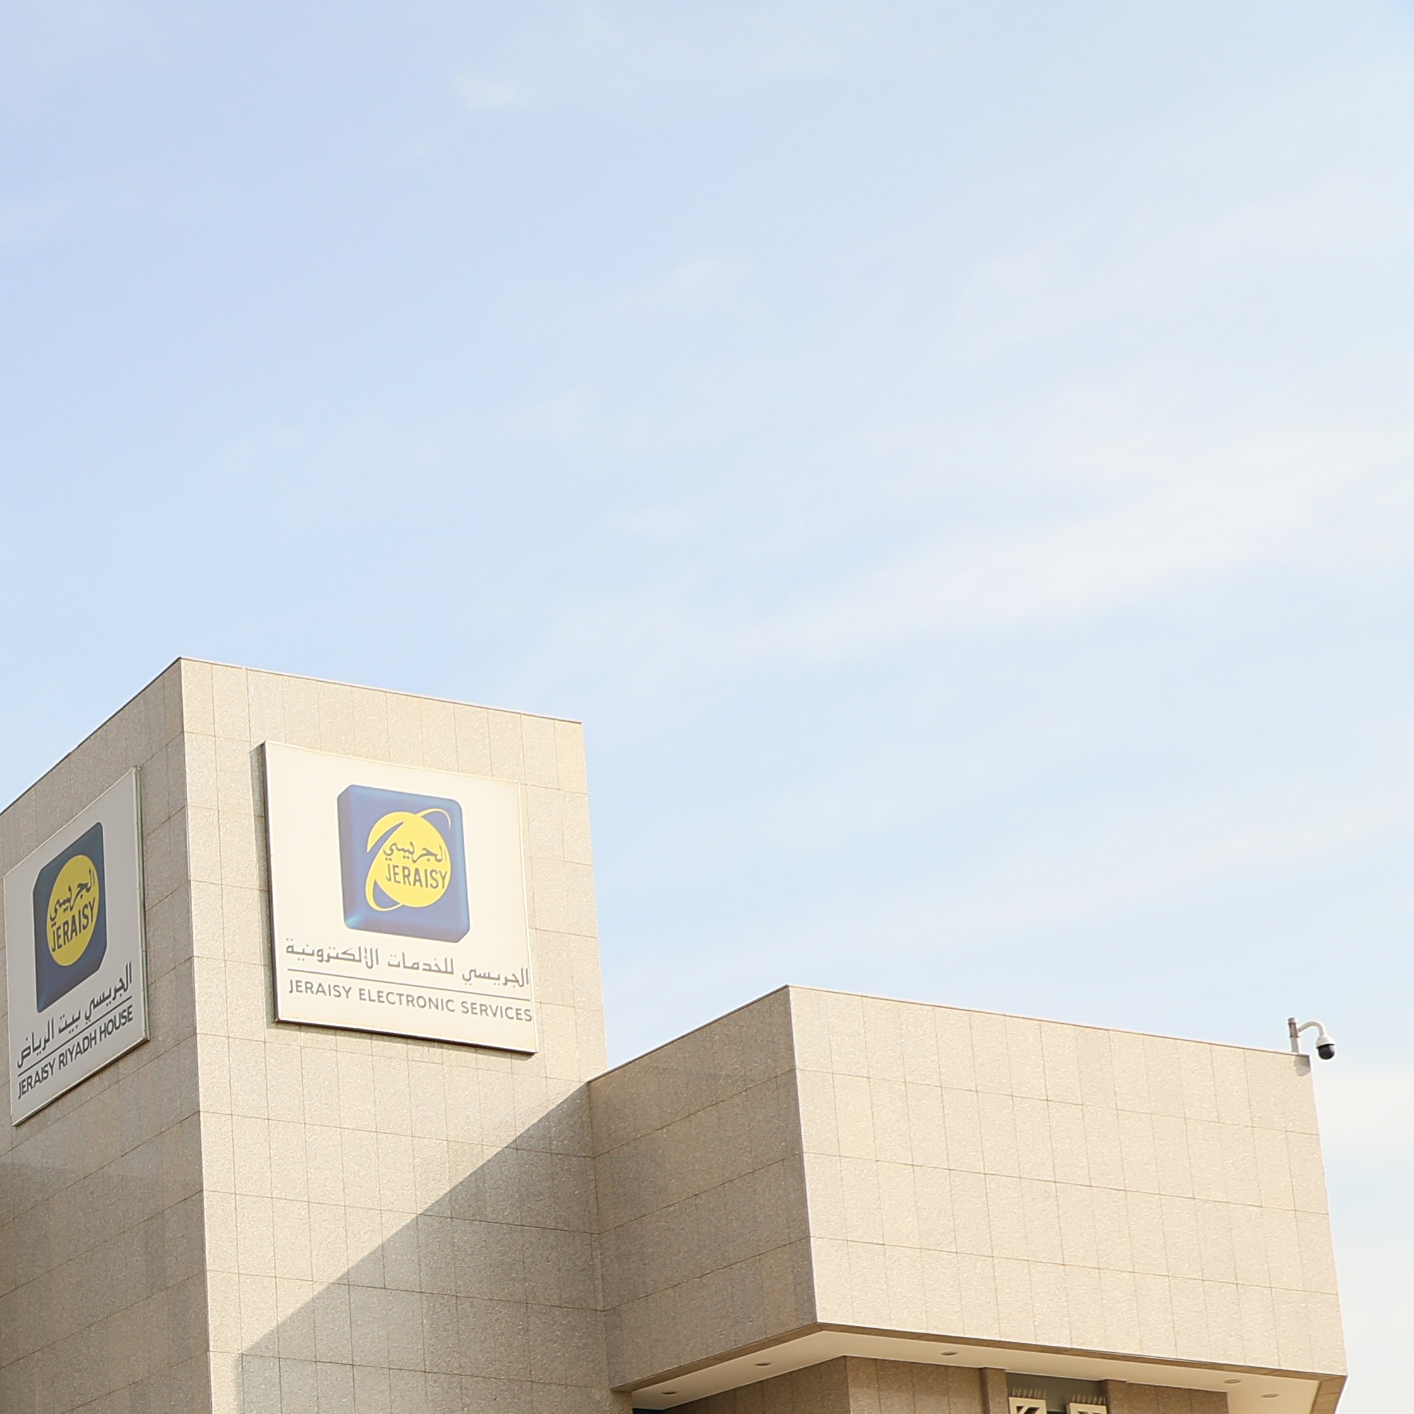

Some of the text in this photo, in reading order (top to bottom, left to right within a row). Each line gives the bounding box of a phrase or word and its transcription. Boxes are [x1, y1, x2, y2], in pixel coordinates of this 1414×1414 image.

[383, 841, 448, 863] الجريسي
[385, 863, 448, 889] JERAISY
[51, 897, 96, 953] JERAISY
[285, 938, 530, 988] الجريسي للخدمات الإلكترونية
[17, 961, 132, 1069] الجريسي بيت الرياض
[288, 978, 533, 1023] JERAISY ELECTRONIC SERVICES
[18, 1004, 134, 1100] JERAISY RIYADH HOUSE
